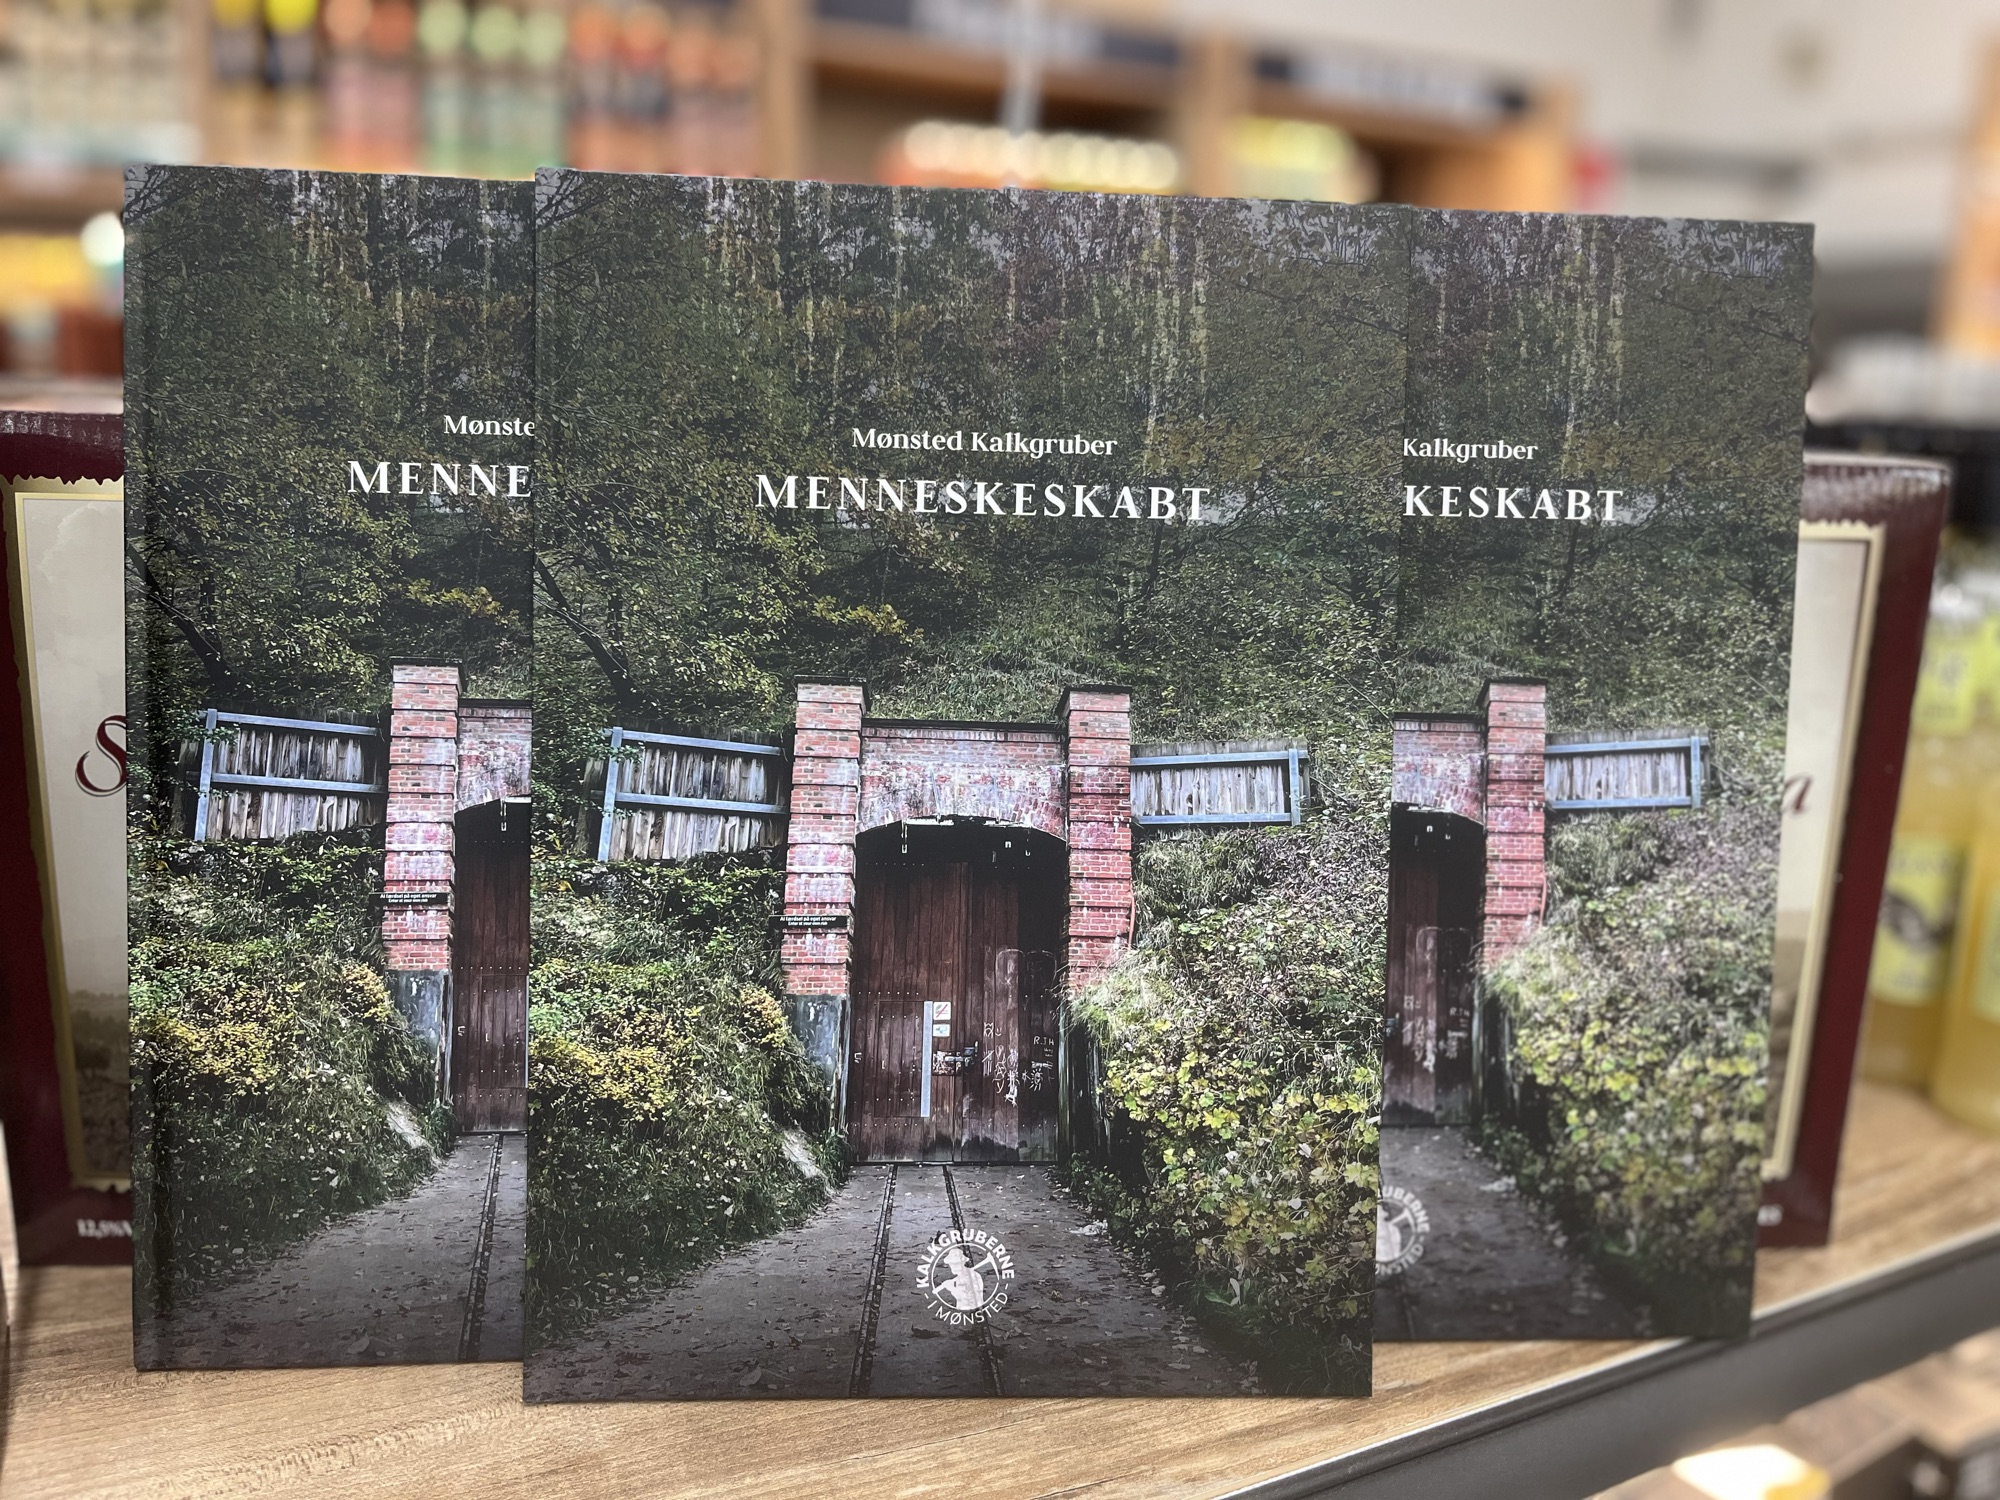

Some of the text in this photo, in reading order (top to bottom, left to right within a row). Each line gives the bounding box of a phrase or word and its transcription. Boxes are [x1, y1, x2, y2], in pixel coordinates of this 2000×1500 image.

[851, 427, 1119, 459] Mønsted Kalkgruber
[1403, 437, 1539, 463] Kalkgruber
[348, 461, 532, 498] MENNE
[755, 474, 1210, 520] MENNESKESKABT
[1403, 485, 1623, 520] KESKABT
[916, 1229, 1014, 1288] KALKGRUBERNE
[935, 1292, 1008, 1326] MØNSTED
